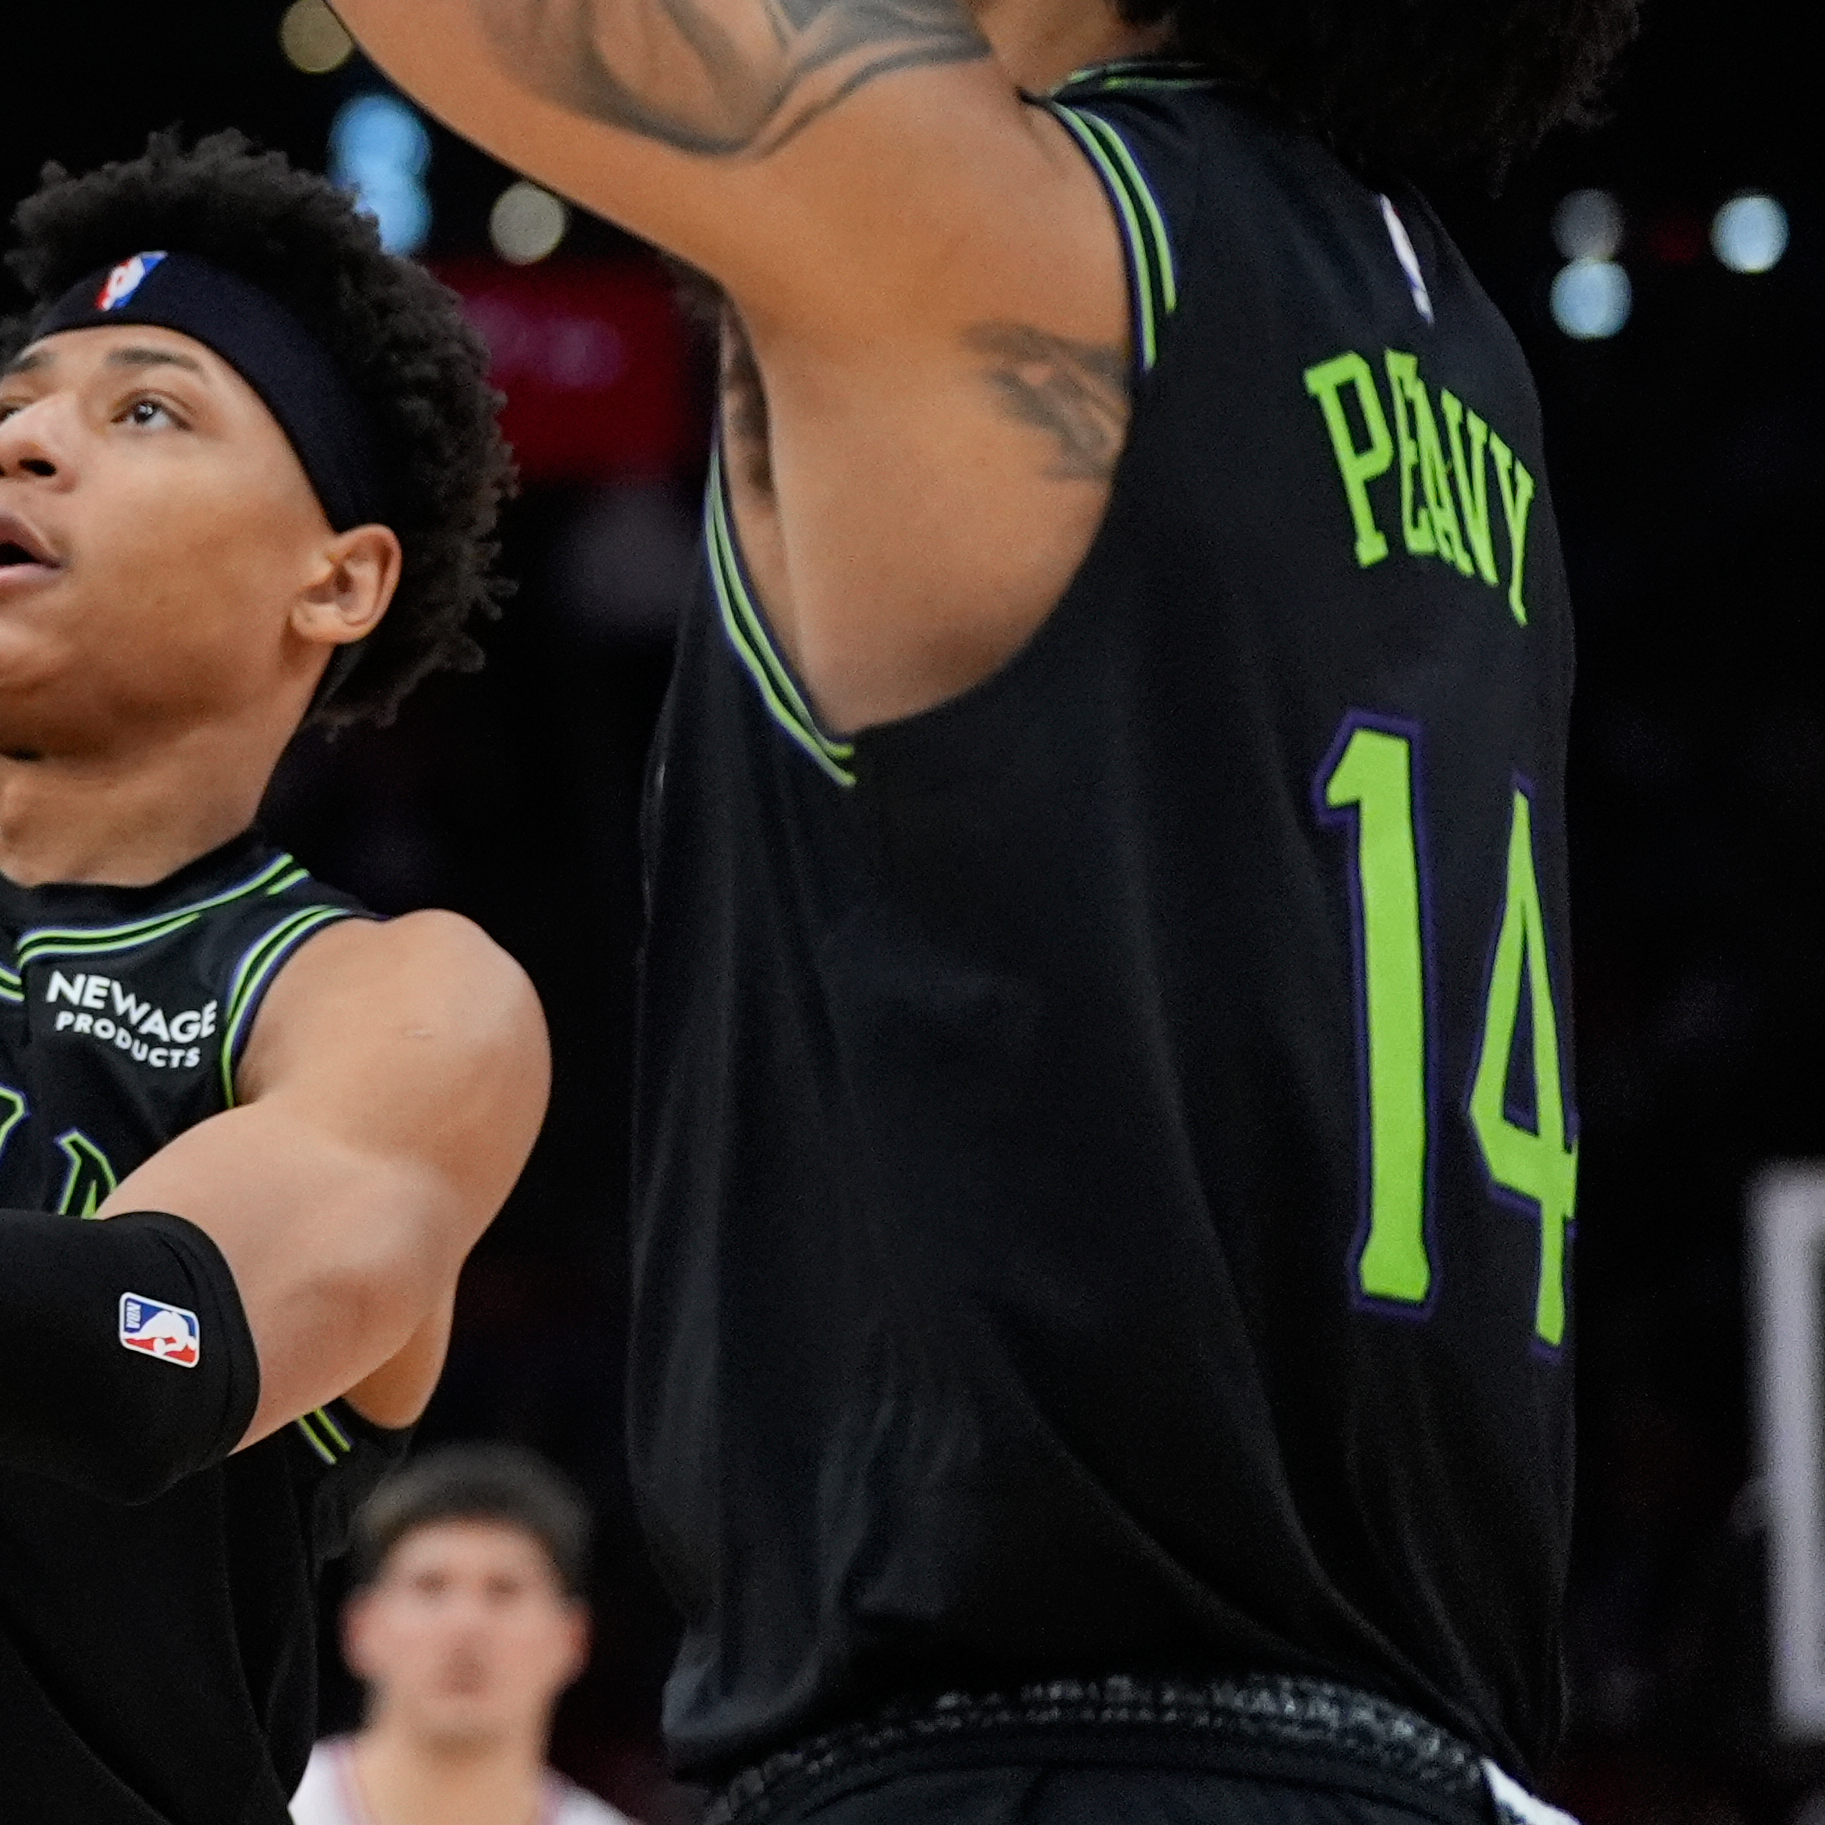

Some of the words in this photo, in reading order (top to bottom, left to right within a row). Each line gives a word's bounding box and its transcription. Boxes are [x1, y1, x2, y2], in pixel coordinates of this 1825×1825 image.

[1303, 346, 1535, 628] PEAVY
[55, 1010, 201, 1068] PRODUCTS
[1320, 721, 1578, 1351] 14
